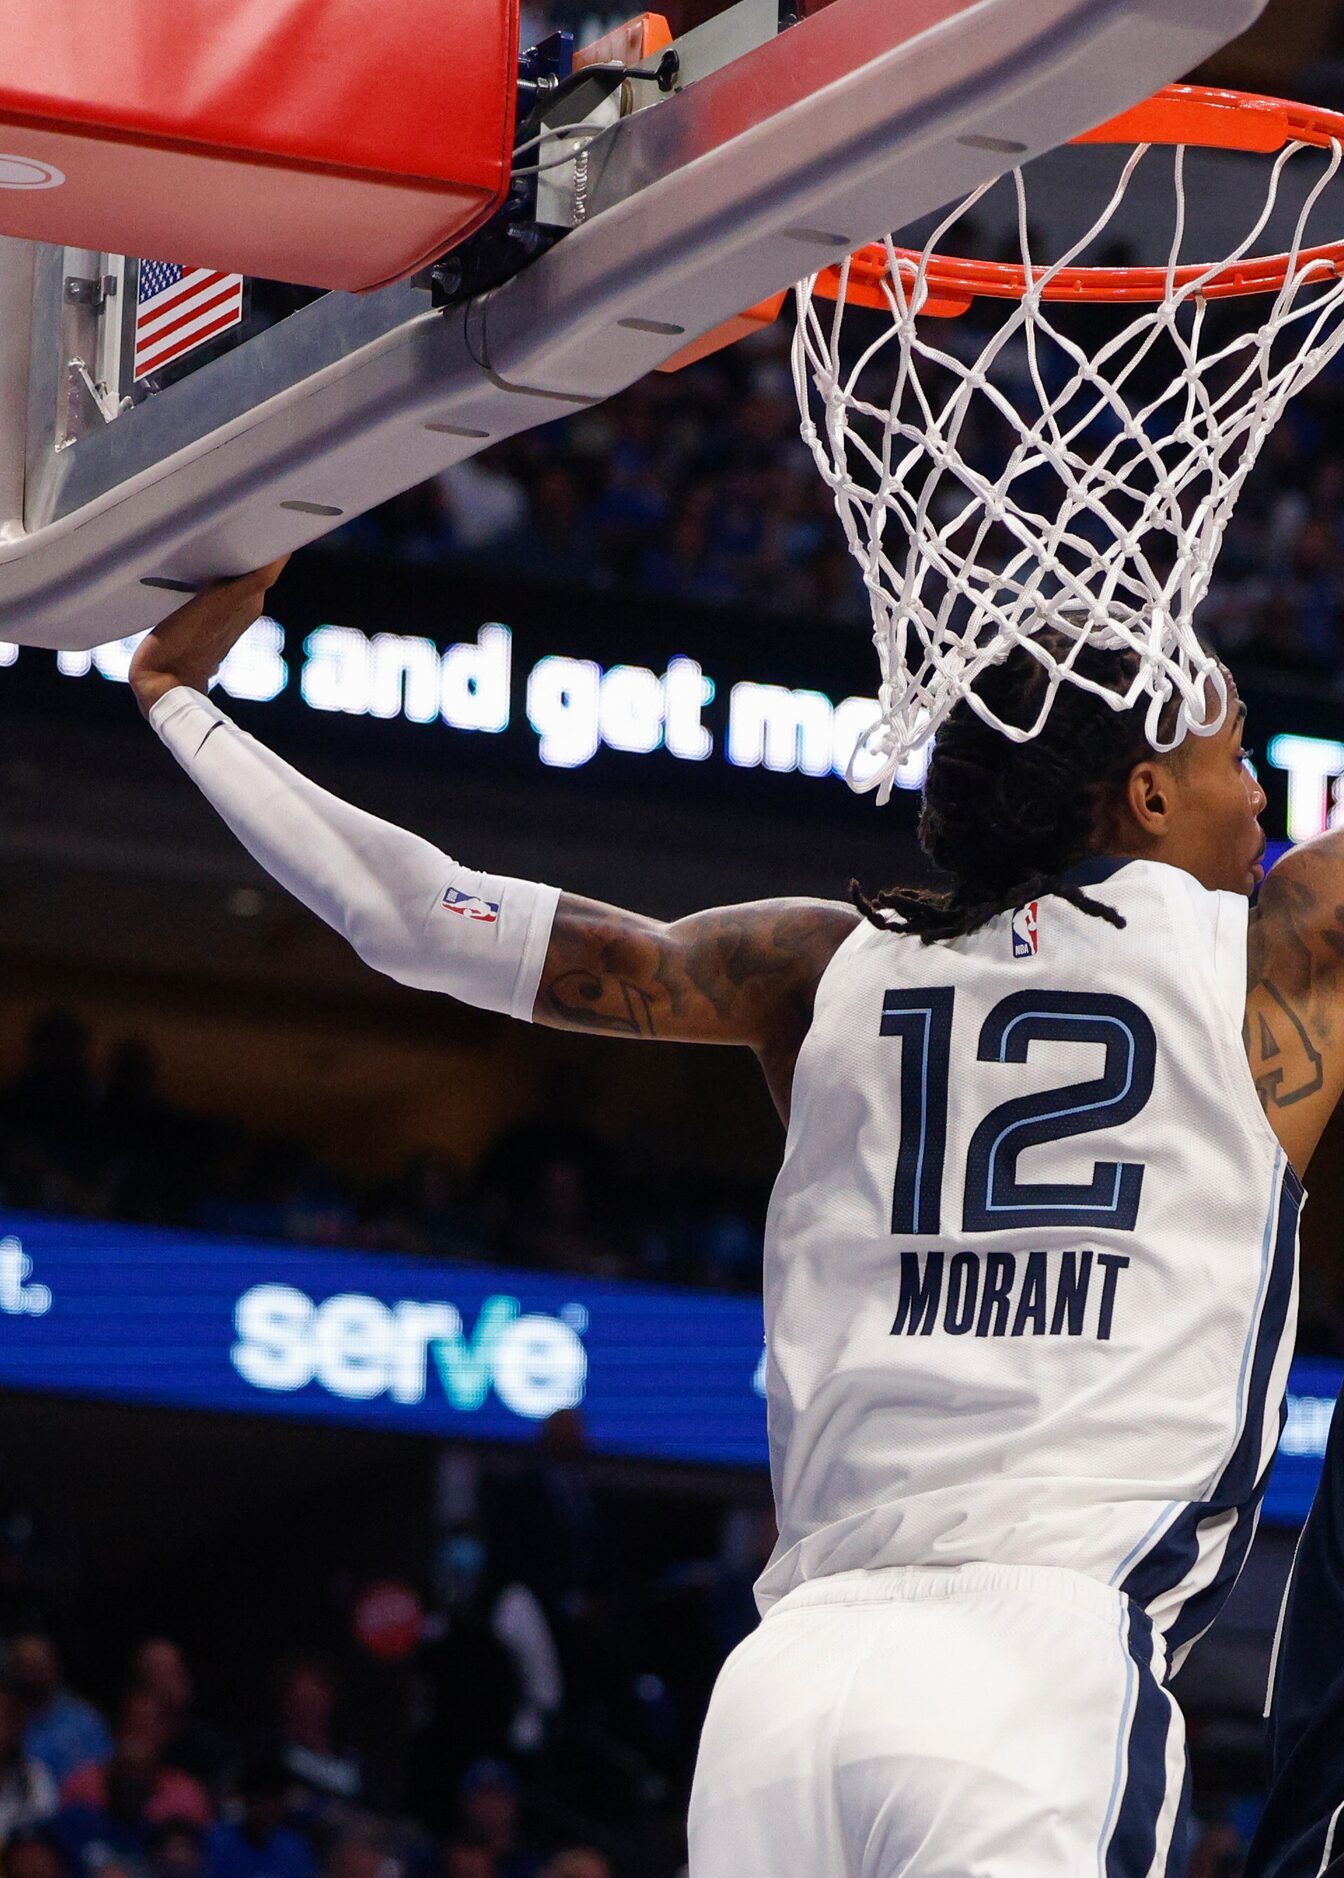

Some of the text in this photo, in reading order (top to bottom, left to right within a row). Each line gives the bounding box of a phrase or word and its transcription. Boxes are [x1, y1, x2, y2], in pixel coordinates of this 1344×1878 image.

[301, 622, 512, 734] and
[526, 653, 715, 768] get
[879, 985, 1157, 1235] 12
[229, 1281, 588, 1419] serve
[889, 1250, 1131, 1341] MORANT
